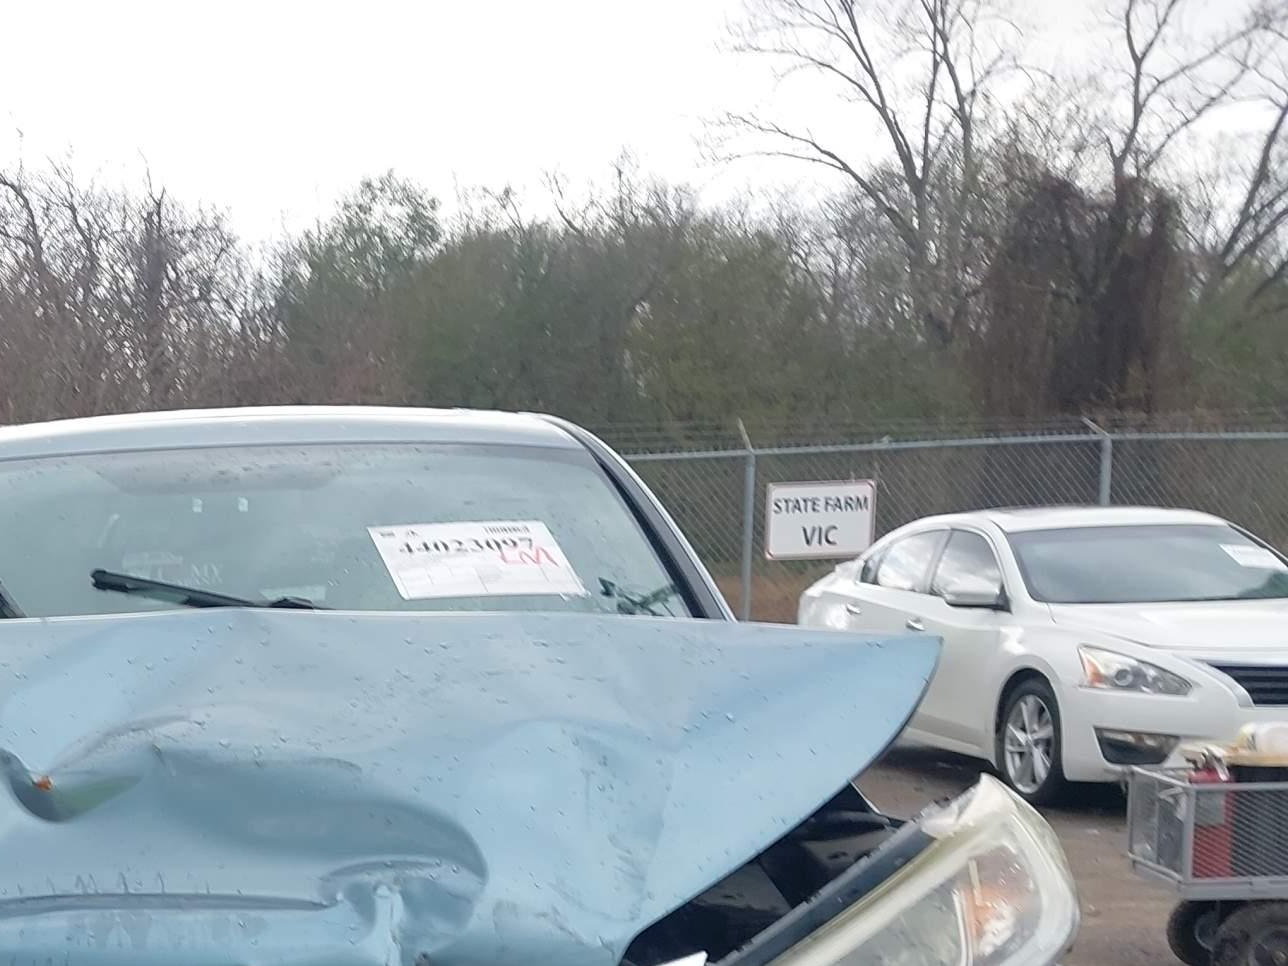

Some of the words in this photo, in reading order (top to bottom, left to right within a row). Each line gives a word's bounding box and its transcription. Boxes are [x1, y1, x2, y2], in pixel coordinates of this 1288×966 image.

[773, 497, 820, 514] STATE
[824, 496, 869, 512] FARM
[801, 525, 839, 546] VIC
[398, 536, 534, 554] 44023097
